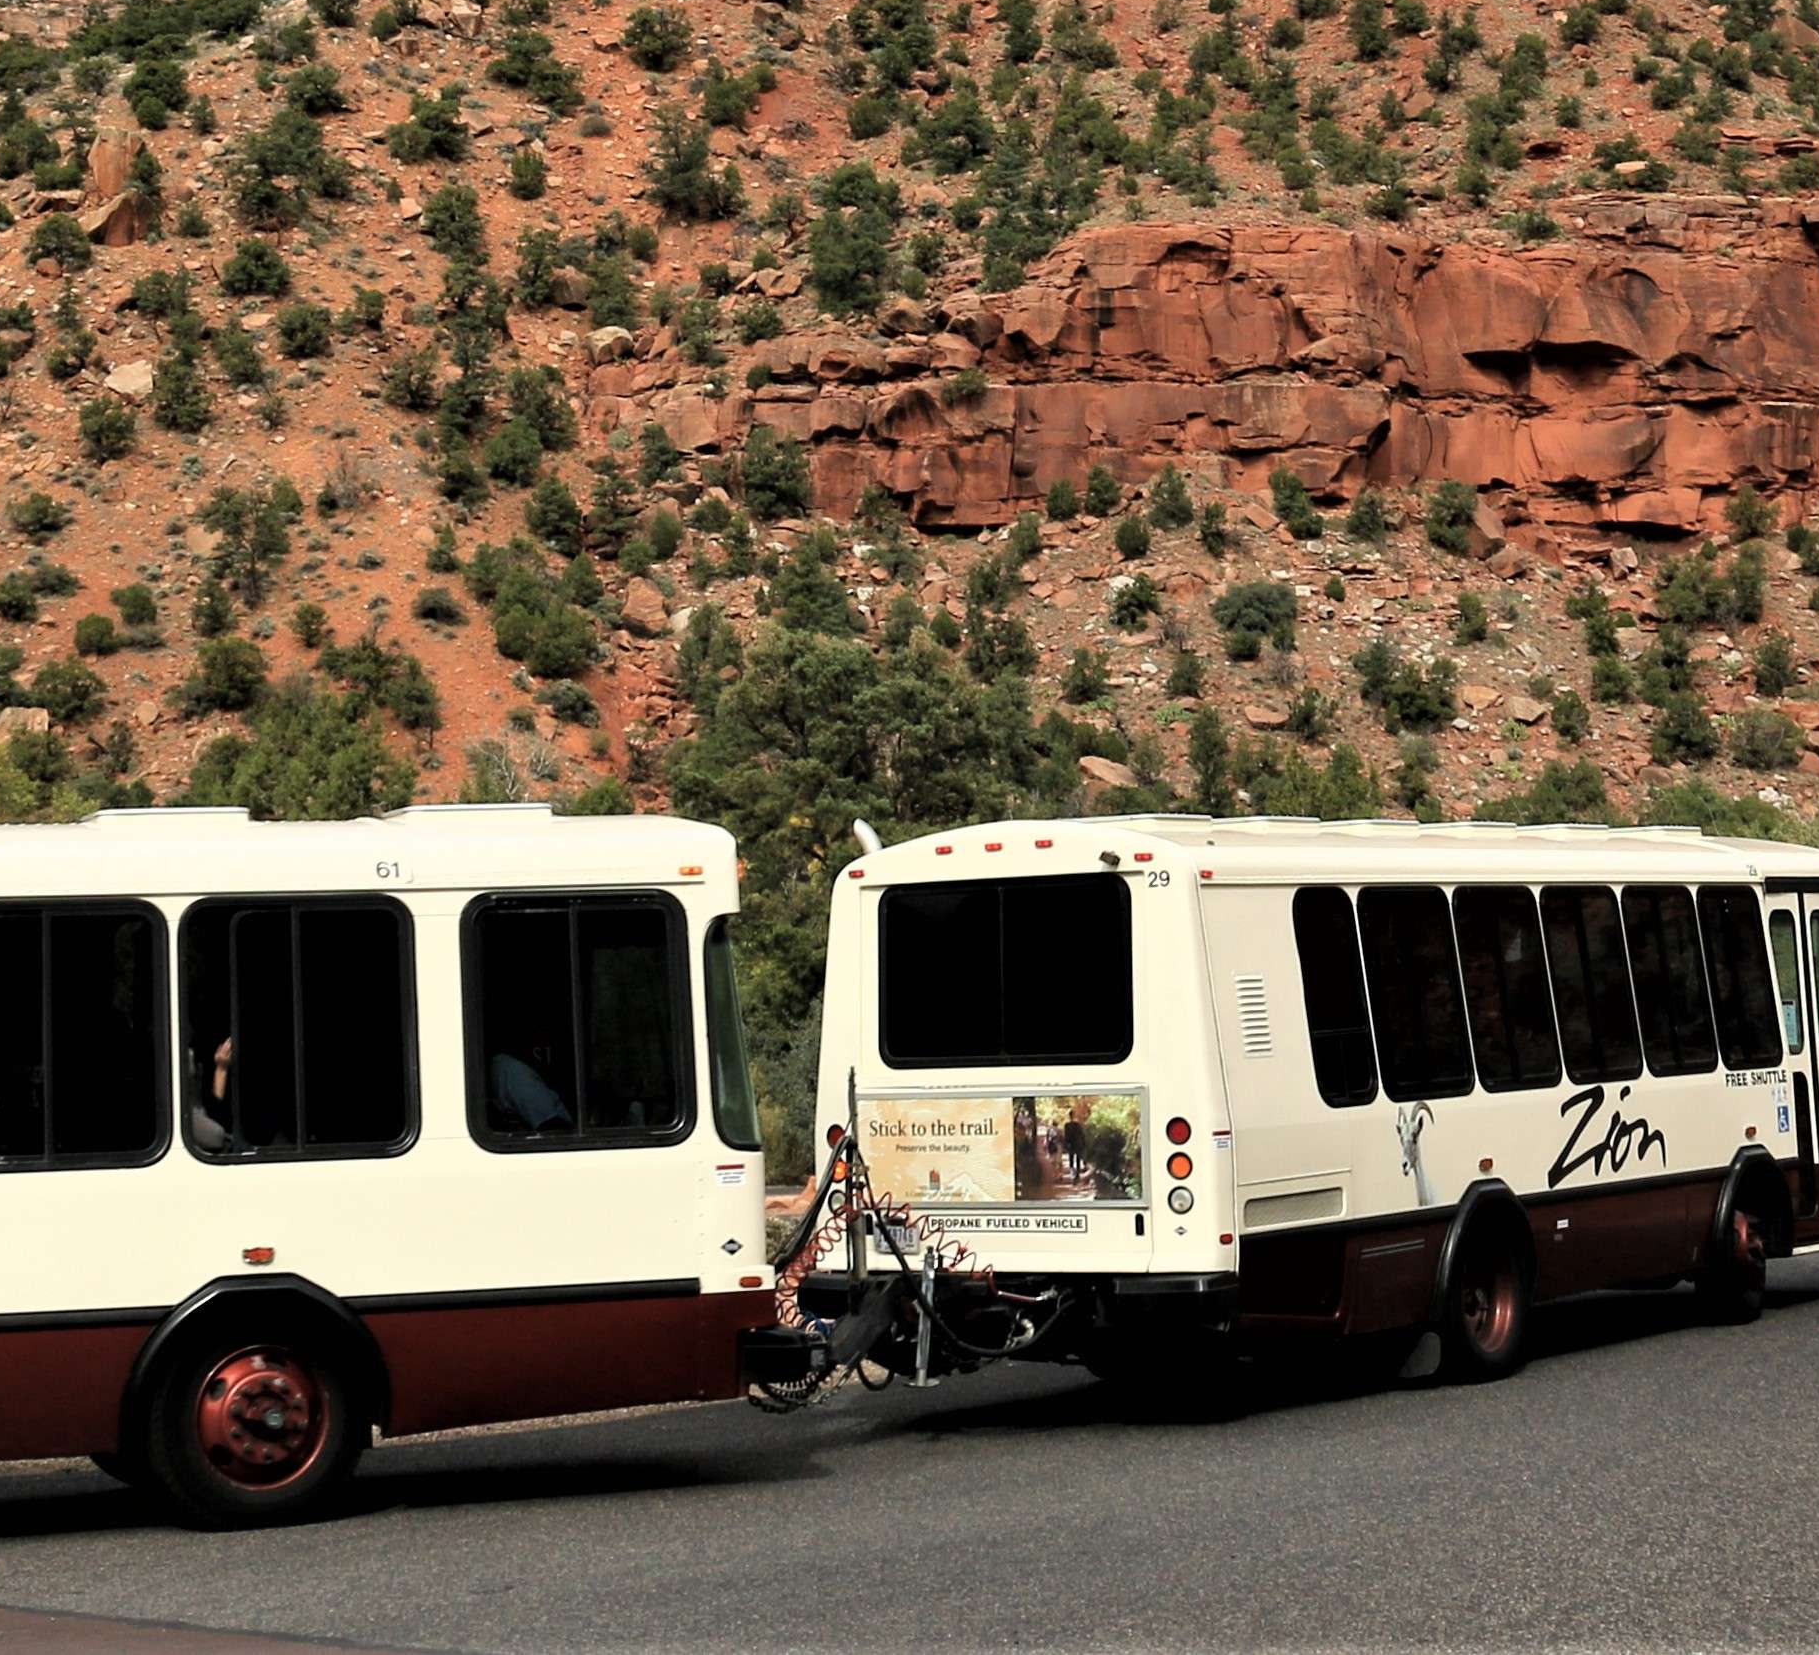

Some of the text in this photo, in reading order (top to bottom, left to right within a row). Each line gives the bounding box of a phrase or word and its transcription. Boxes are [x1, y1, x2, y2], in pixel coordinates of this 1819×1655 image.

[376, 860, 399, 878] 61
[1148, 870, 1170, 888] 29
[1725, 1069, 1787, 1087] FREE SHUTTLE
[869, 1117, 999, 1138] Stick to the trail.
[1547, 1084, 1667, 1190] Zion
[895, 1143, 927, 1153] Preserve
[929, 1143, 942, 1153] the
[930, 1218, 1084, 1229] PROPANE FUELED VEHICLE
